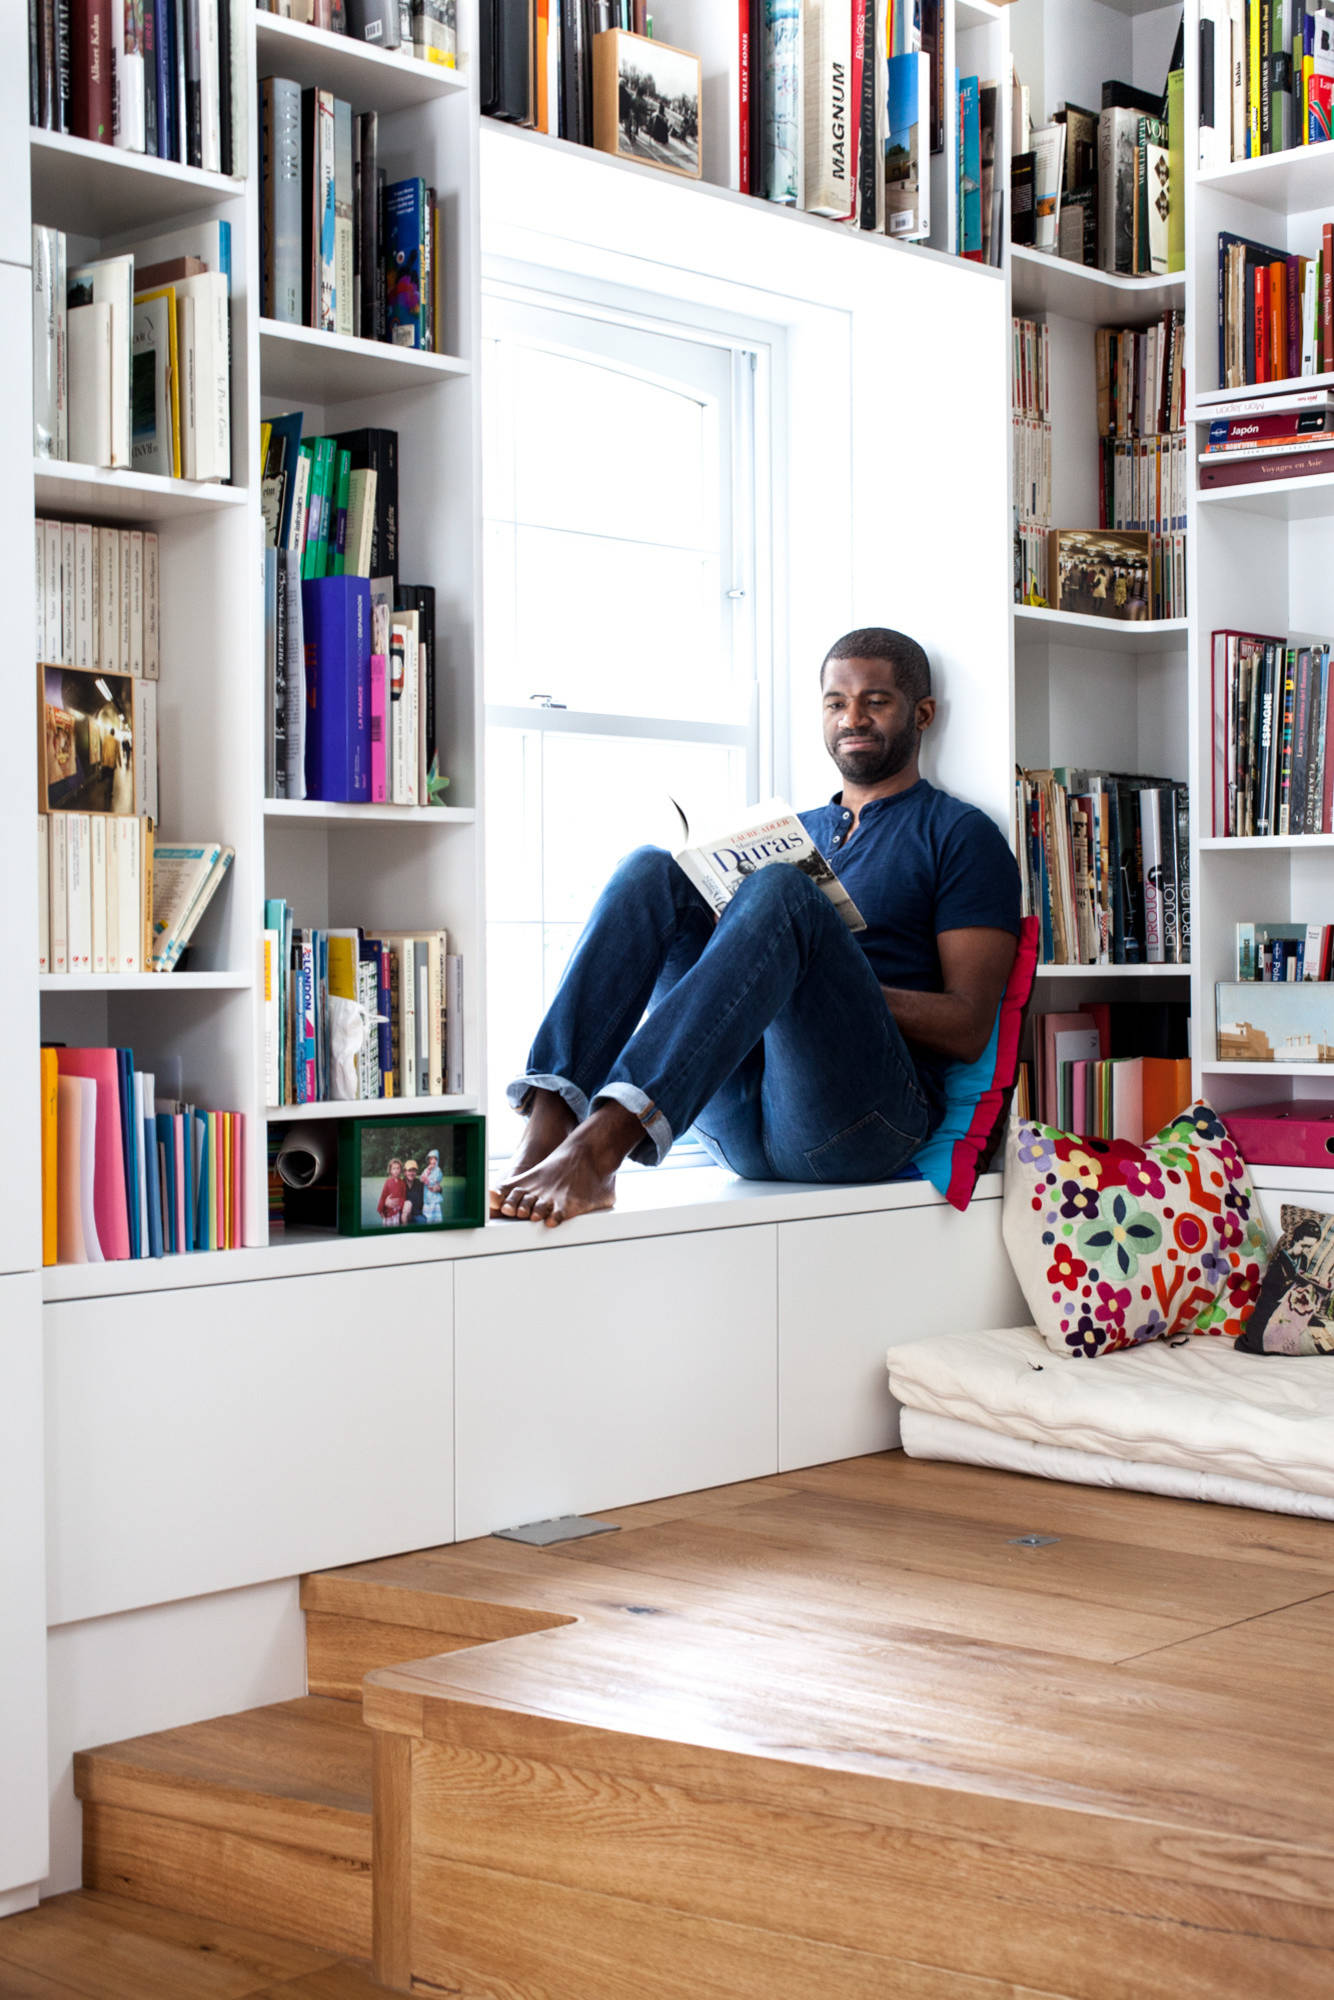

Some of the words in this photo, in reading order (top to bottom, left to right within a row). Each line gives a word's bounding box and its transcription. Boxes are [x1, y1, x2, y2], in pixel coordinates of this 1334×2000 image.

[90, 14, 100, 46] Kahn
[90, 48, 101, 84] Albert
[832, 62, 846, 181] MAGNUM
[1102, 115, 1112, 169] AFRICA
[1231, 425, 1260, 437] Japón
[1261, 692, 1272, 748] ESPAGNE
[1306, 763, 1317, 825] FLAMENCO
[712, 832, 804, 873] Duras
[761, 819, 791, 833] ADLER
[1147, 881, 1159, 945] DROUOT
[1164, 882, 1176, 947] DROUOT
[1181, 880, 1191, 946] DROUOT
[302, 959, 312, 1011] LONDON
